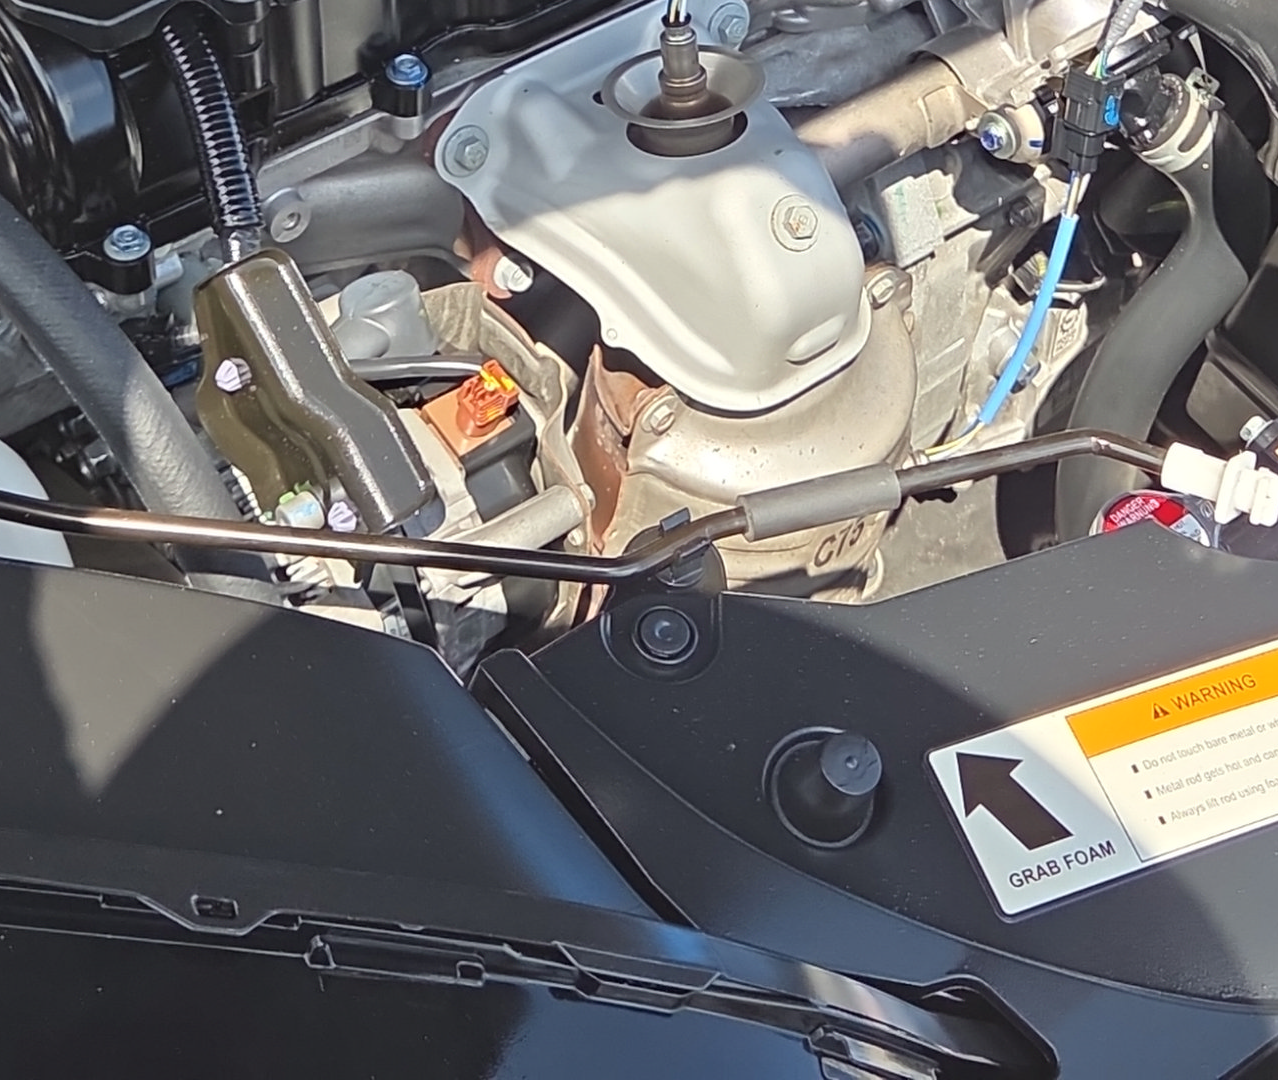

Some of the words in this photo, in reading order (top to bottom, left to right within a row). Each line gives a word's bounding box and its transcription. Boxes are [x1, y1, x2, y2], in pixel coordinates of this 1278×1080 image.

[1109, 496, 1145, 523] DANGER
[1170, 674, 1256, 710] WARNING
[1142, 759, 1159, 770] Do
[1160, 752, 1177, 764] not
[1177, 743, 1205, 758] touch
[1204, 734, 1228, 749] bare
[1229, 725, 1255, 741] metal
[1256, 723, 1267, 733] or
[1155, 778, 1185, 796] Metal
[1185, 773, 1202, 786] rod
[1203, 766, 1225, 782] gets
[1224, 760, 1243, 772] hot
[1243, 753, 1262, 767] and
[1170, 804, 1206, 821] Always
[1205, 797, 1220, 809] lift
[1220, 791, 1238, 805] rod
[1237, 783, 1266, 798] using
[1009, 859, 1061, 888] GRAB
[1063, 840, 1116, 870] FOAM
